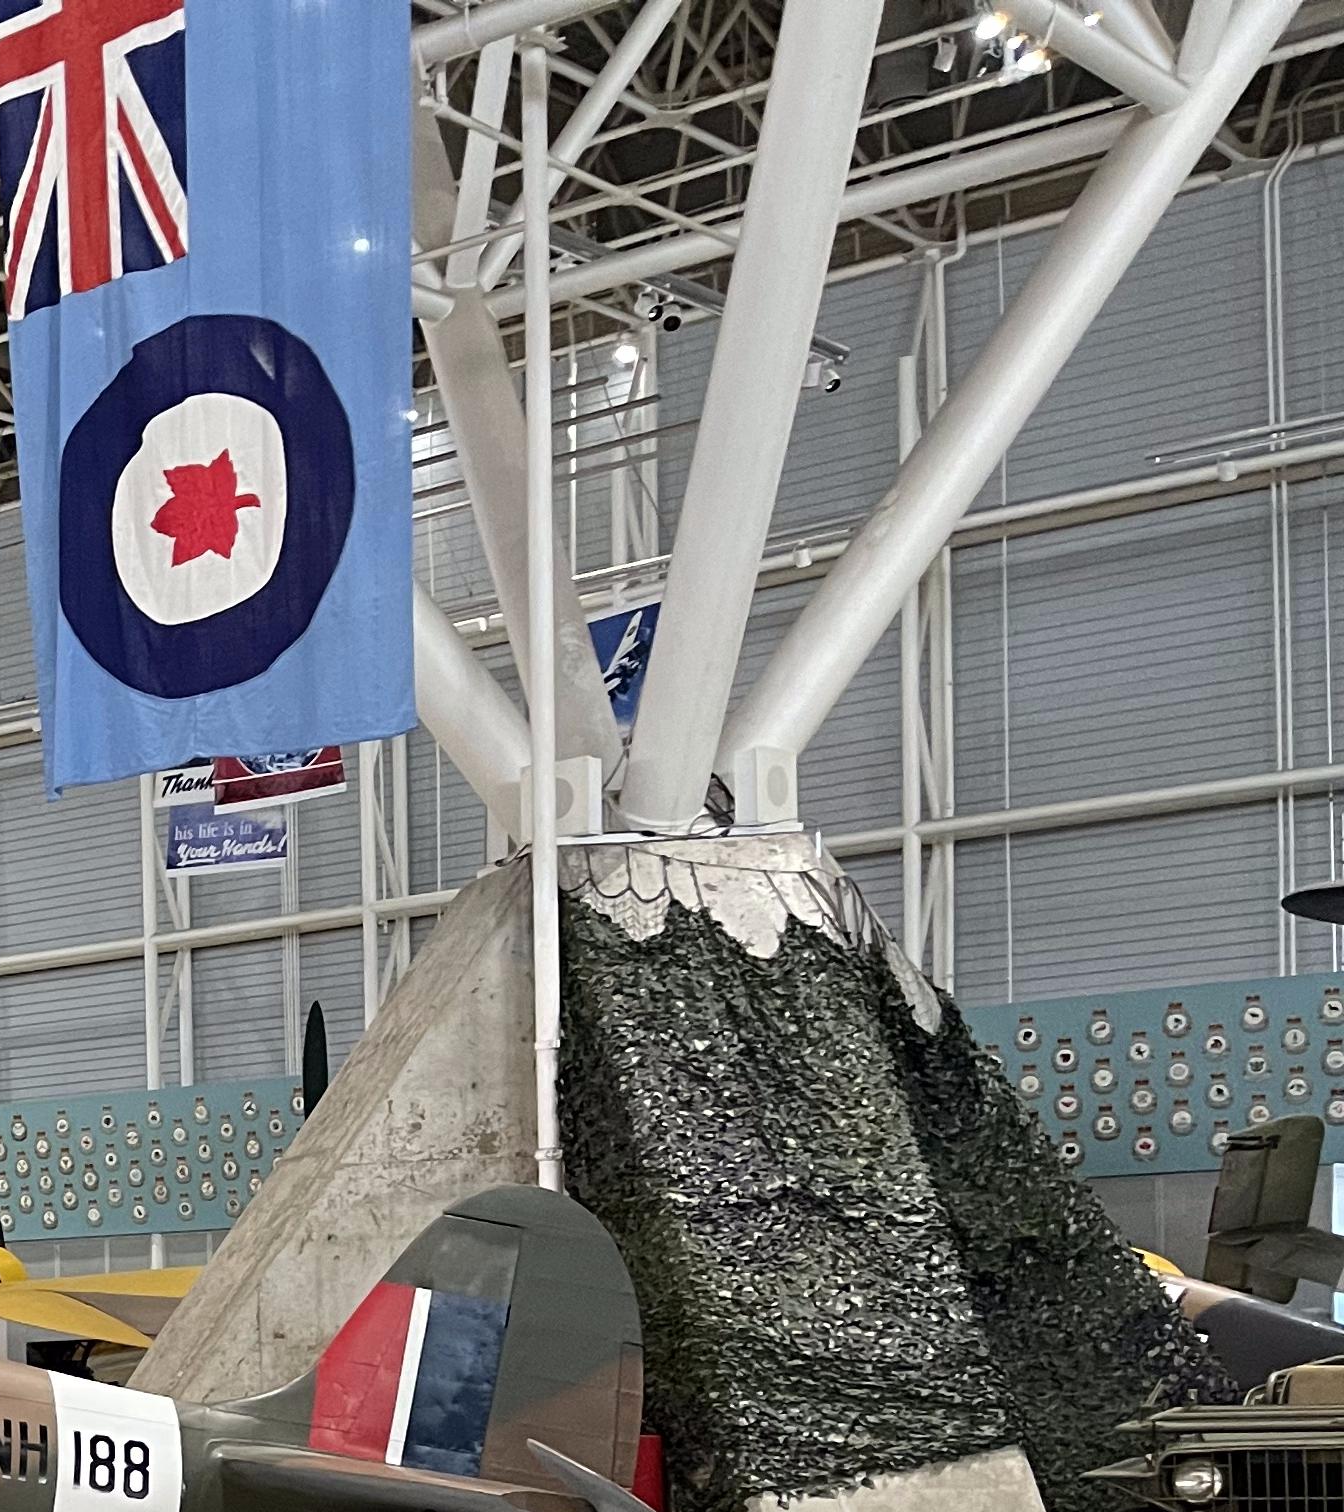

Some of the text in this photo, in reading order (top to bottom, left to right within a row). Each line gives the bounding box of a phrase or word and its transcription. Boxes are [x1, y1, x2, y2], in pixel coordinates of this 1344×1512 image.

[174, 820, 253, 841] his life is in
[176, 834, 287, 863] Your Hands!
